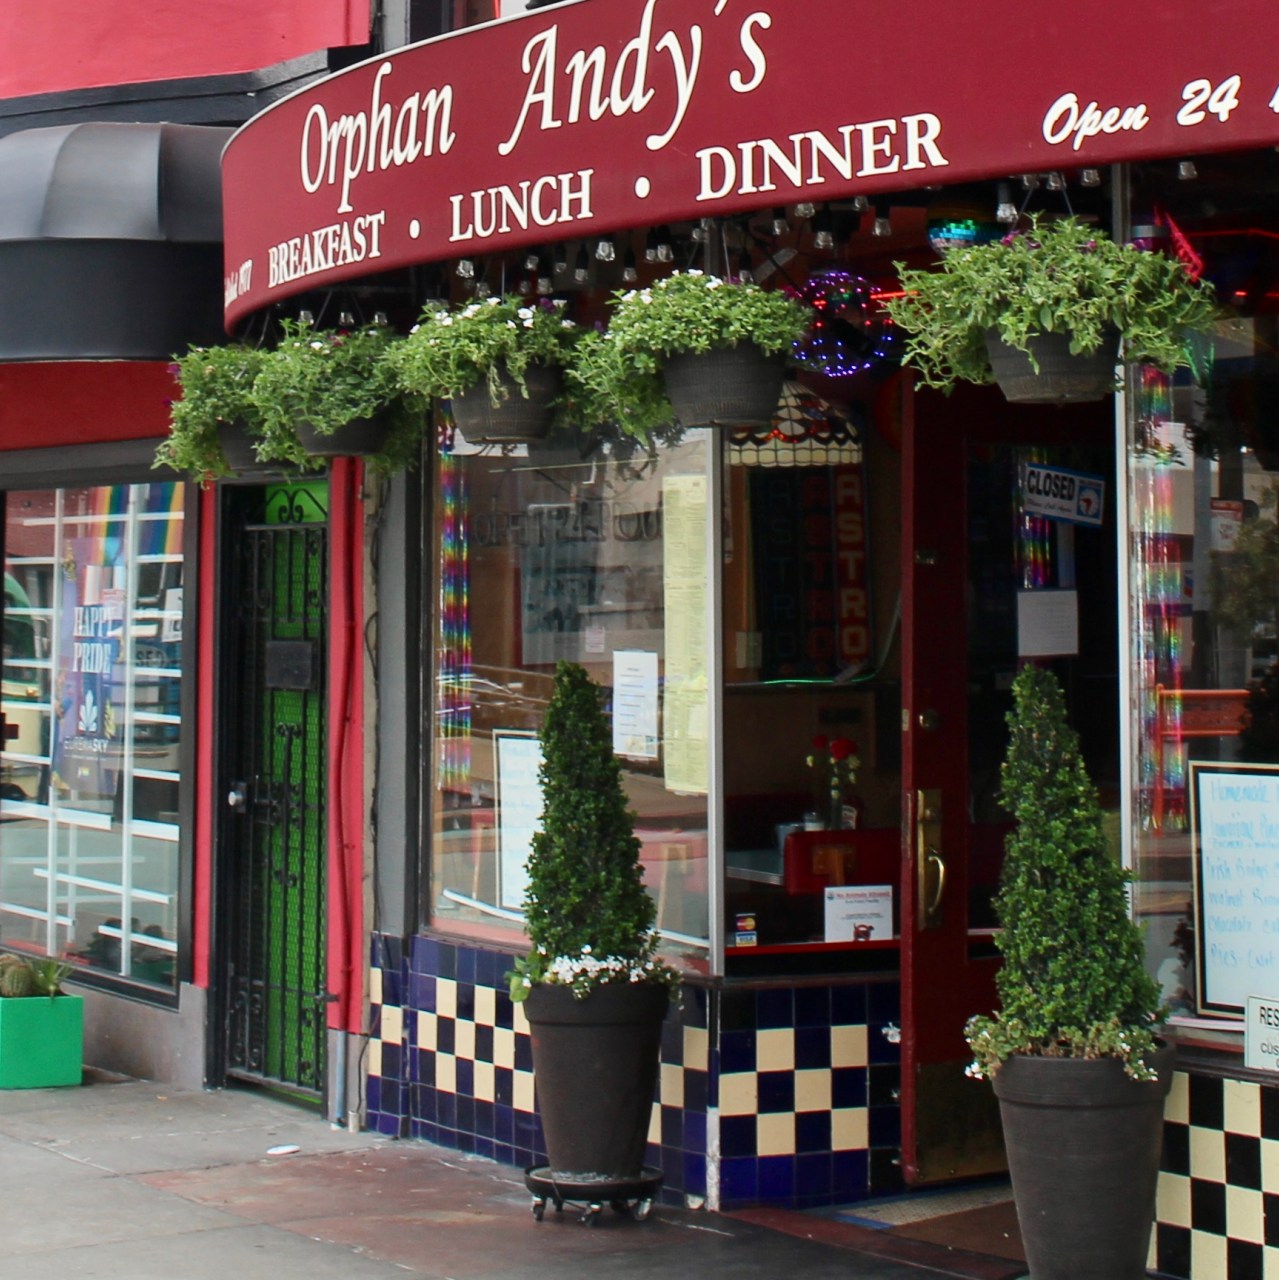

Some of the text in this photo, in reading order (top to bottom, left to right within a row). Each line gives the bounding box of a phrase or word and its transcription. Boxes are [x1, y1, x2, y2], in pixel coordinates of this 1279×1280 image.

[300, 62, 457, 213] Orphan
[1042, 92, 1150, 151] Open
[1176, 74, 1242, 127] 24
[267, 113, 949, 289] BREAKFAST LUNCH DINNER
[1027, 470, 1076, 501] CLOSED
[73, 606, 114, 637] HAPPY
[73, 643, 111, 673] PRIDE
